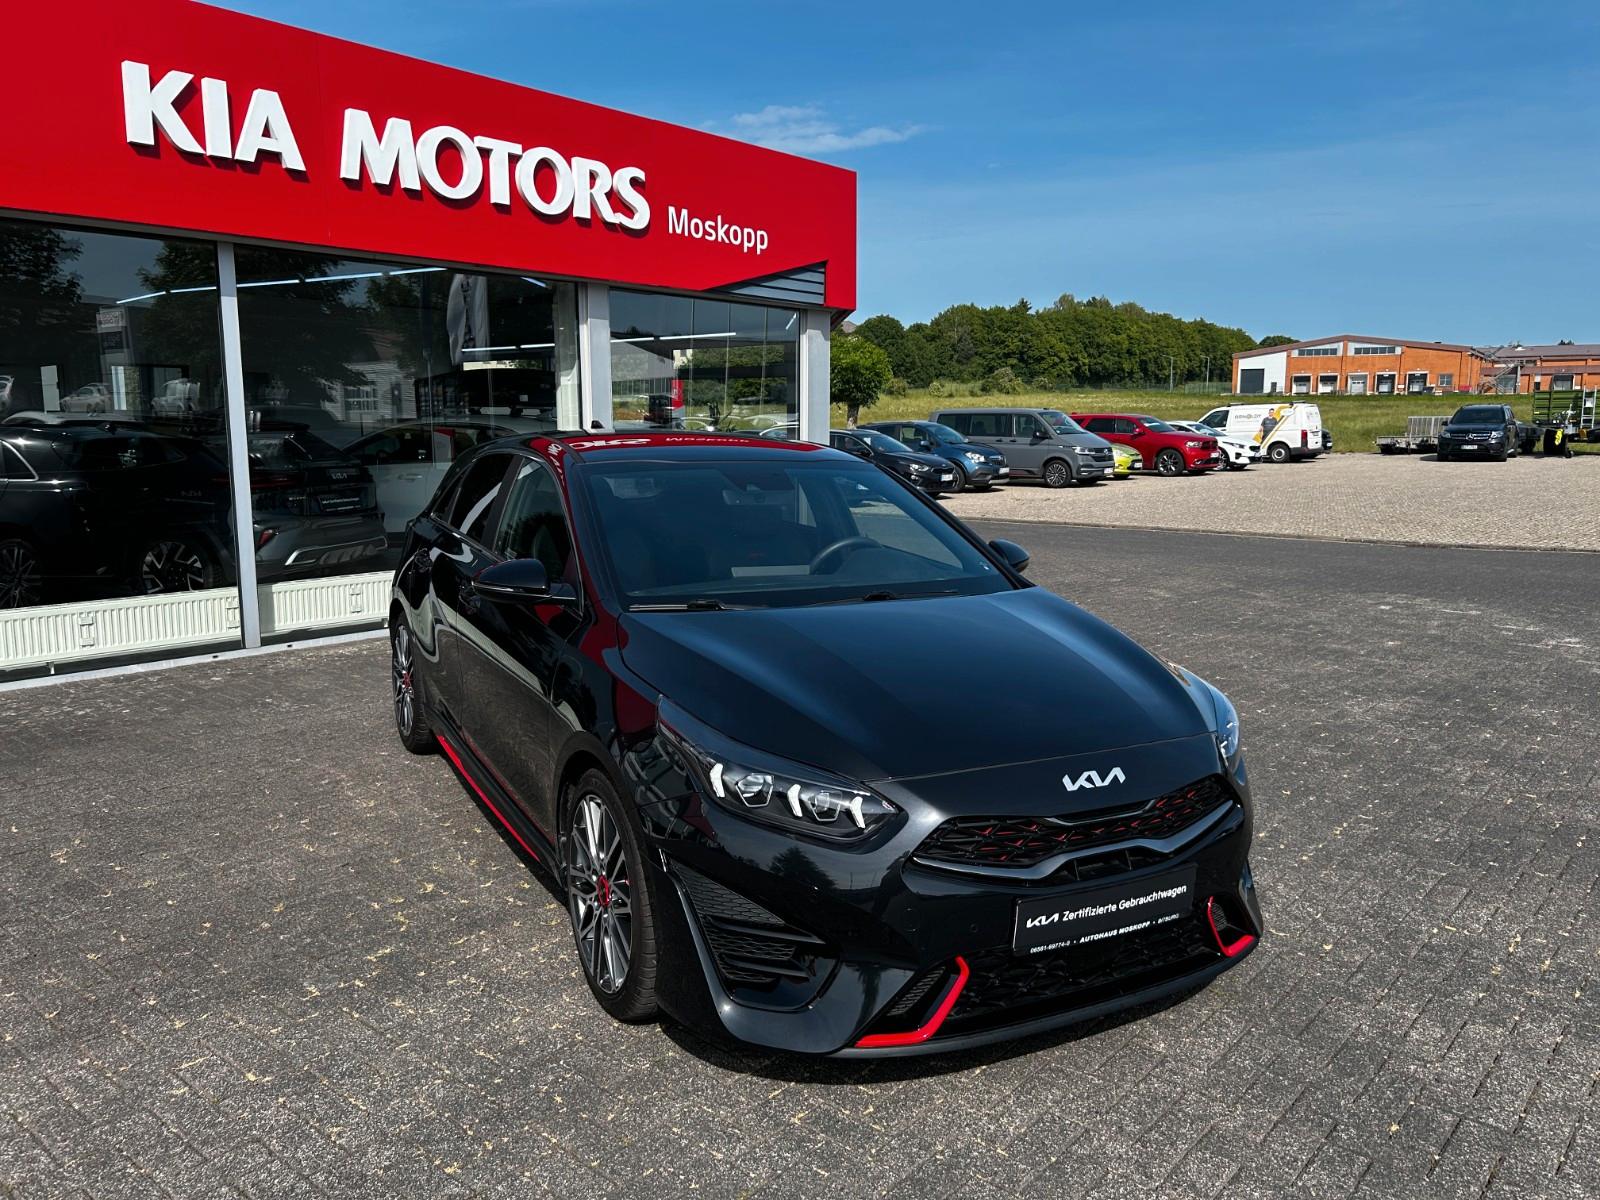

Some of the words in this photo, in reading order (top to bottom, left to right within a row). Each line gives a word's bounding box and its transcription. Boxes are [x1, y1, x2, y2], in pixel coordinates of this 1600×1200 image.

[121, 60, 307, 172] KIA
[339, 107, 651, 231] MOTORS
[667, 205, 769, 255] Moskopp
[1062, 766, 1126, 791] KIA
[1026, 912, 1060, 928] KIA
[1062, 903, 1117, 922] Zertifizierte
[1118, 884, 1187, 910] Gebrauchtwagen
[1079, 929, 1118, 944] AUTOHAUS
[1118, 920, 1151, 935] MOSKOPP
